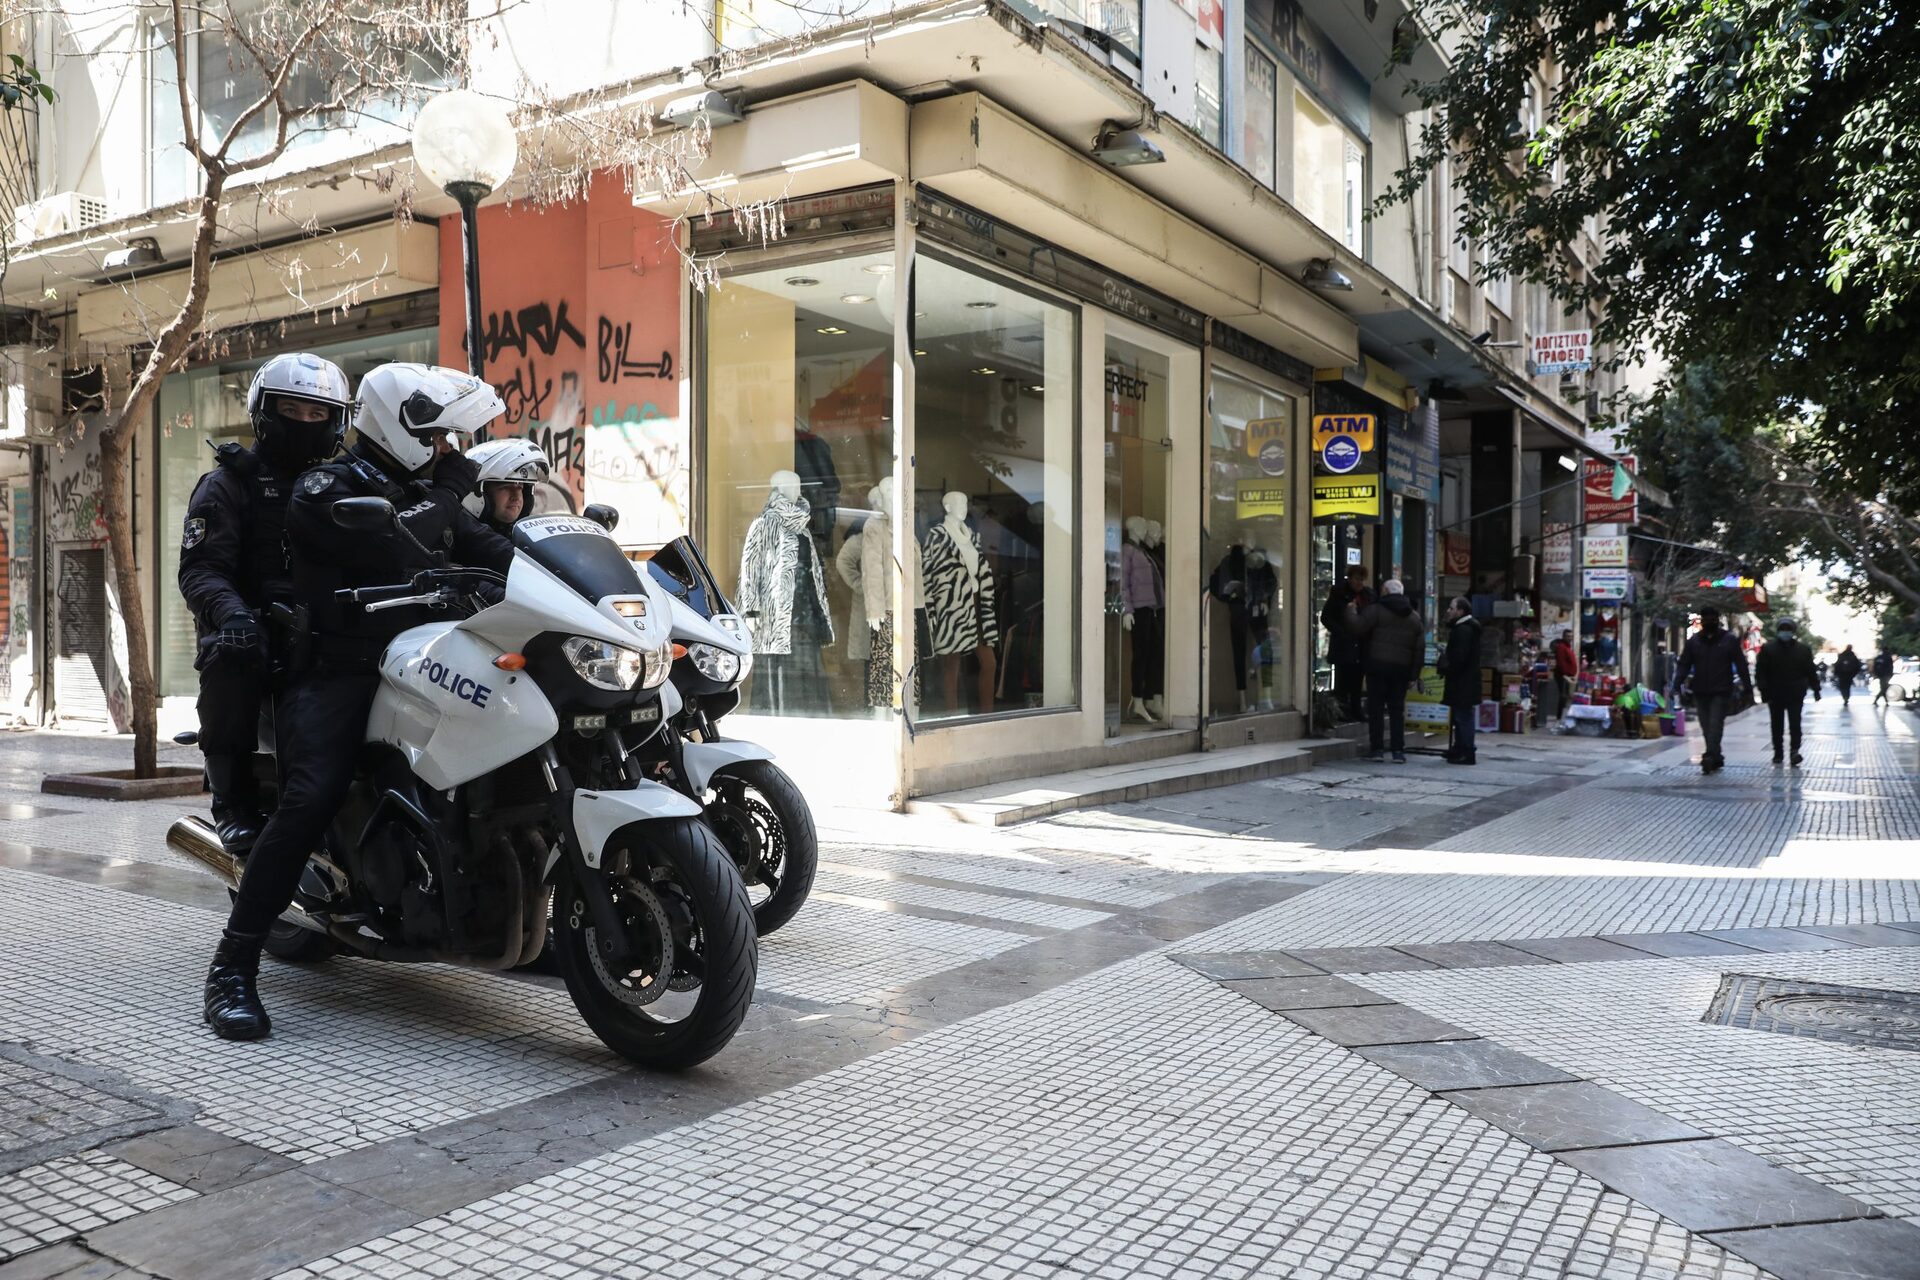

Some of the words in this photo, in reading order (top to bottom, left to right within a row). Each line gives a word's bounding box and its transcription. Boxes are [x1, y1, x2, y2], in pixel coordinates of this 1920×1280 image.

[1246, 47, 1272, 99] CAFE
[462, 300, 586, 363] HARK
[1535, 333, 1588, 350] ΛΟΓΙΣΤΙΚΟ
[1537, 348, 1585, 364] ΓΡΑΦΕΙΟ
[1318, 417, 1369, 433] ATM
[545, 524, 605, 536] POLICE
[418, 656, 492, 710] POLICE
